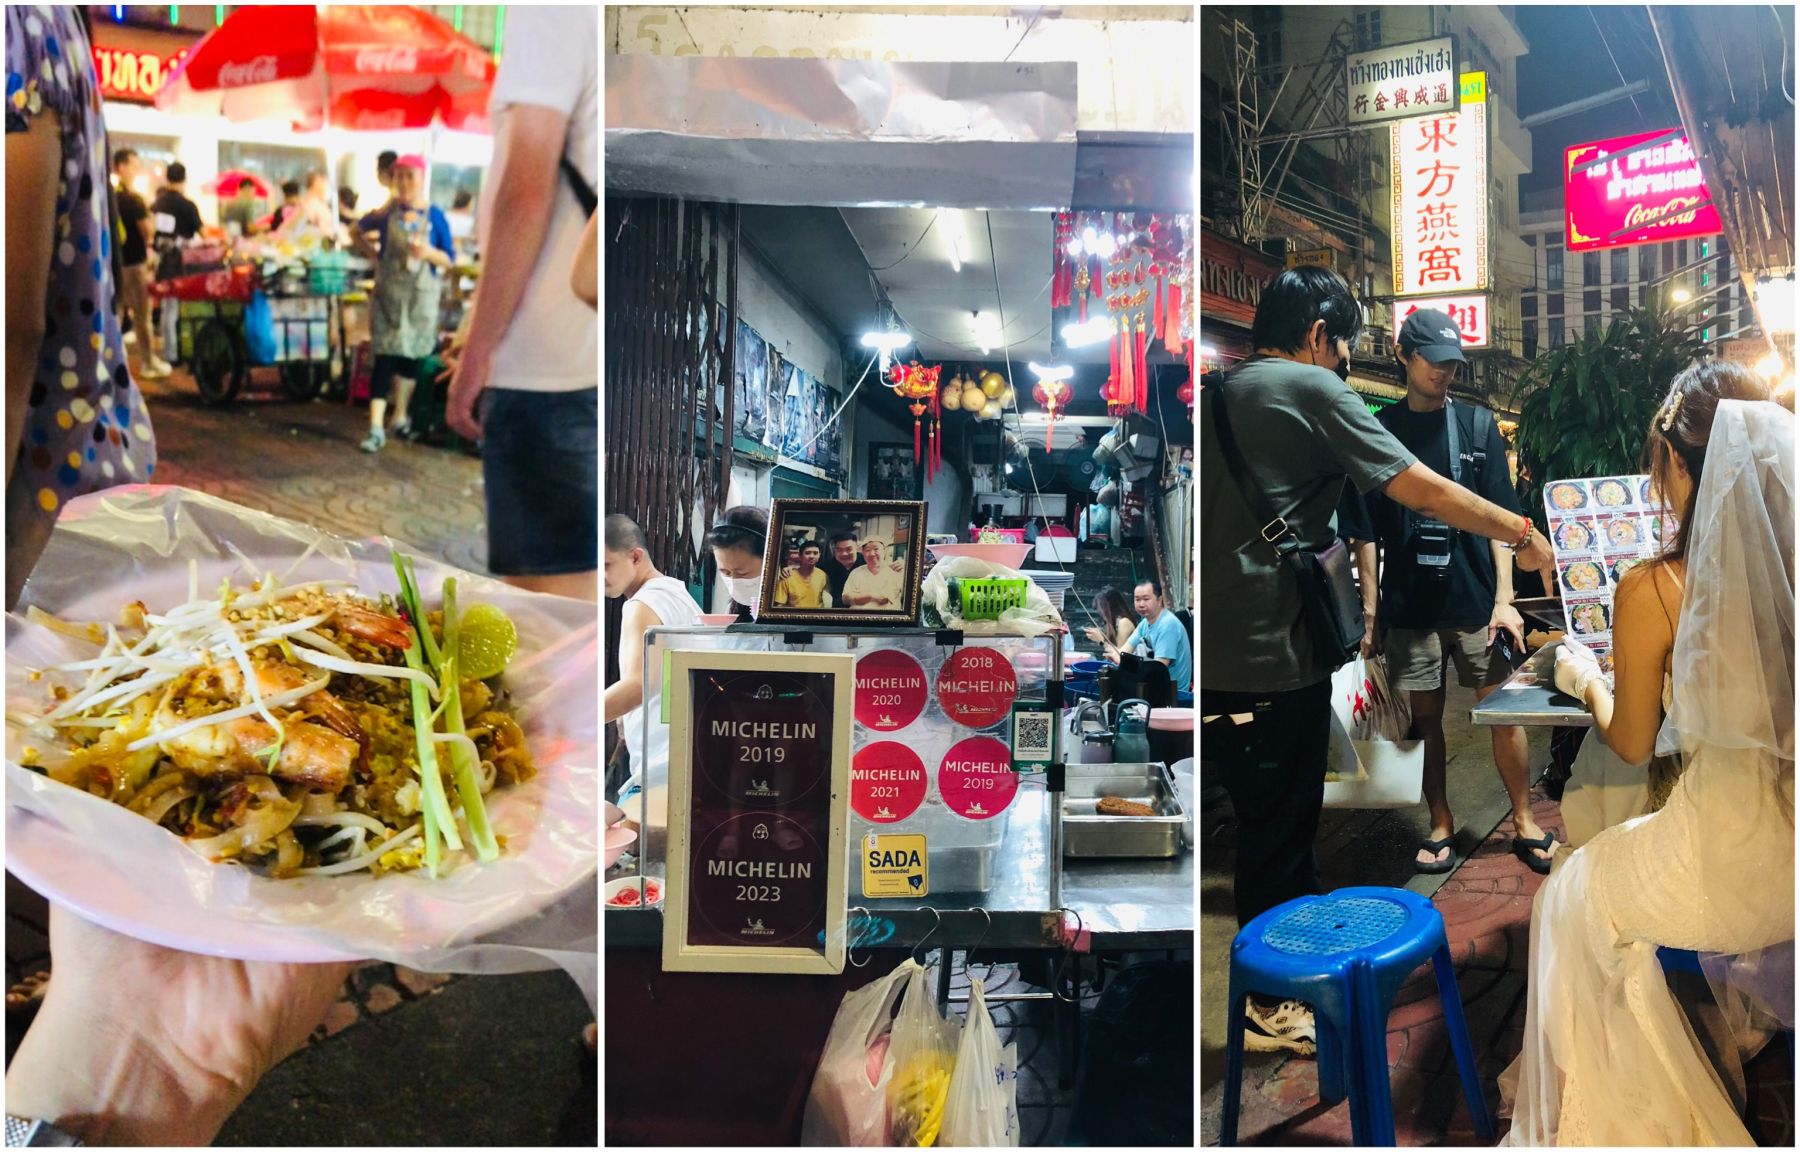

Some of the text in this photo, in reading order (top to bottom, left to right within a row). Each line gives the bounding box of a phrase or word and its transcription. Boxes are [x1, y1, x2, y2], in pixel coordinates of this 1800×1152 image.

[1415, 112, 1463, 287] 東方燕窩
[961, 657, 994, 668] 2018
[855, 677, 920, 689] MICHELIN
[938, 680, 1015, 693] MICHELIN
[872, 694, 902, 706] 2020
[711, 720, 816, 739] MICHELIN
[739, 746, 785, 763] 2019
[945, 760, 1013, 774] MICHELIN
[852, 769, 920, 781] MICHELIN
[963, 777, 994, 790] 2019
[870, 786, 900, 798] 2021
[869, 849, 922, 868] SADA
[708, 859, 812, 879] MICHELIN
[735, 885, 782, 902] 2023
